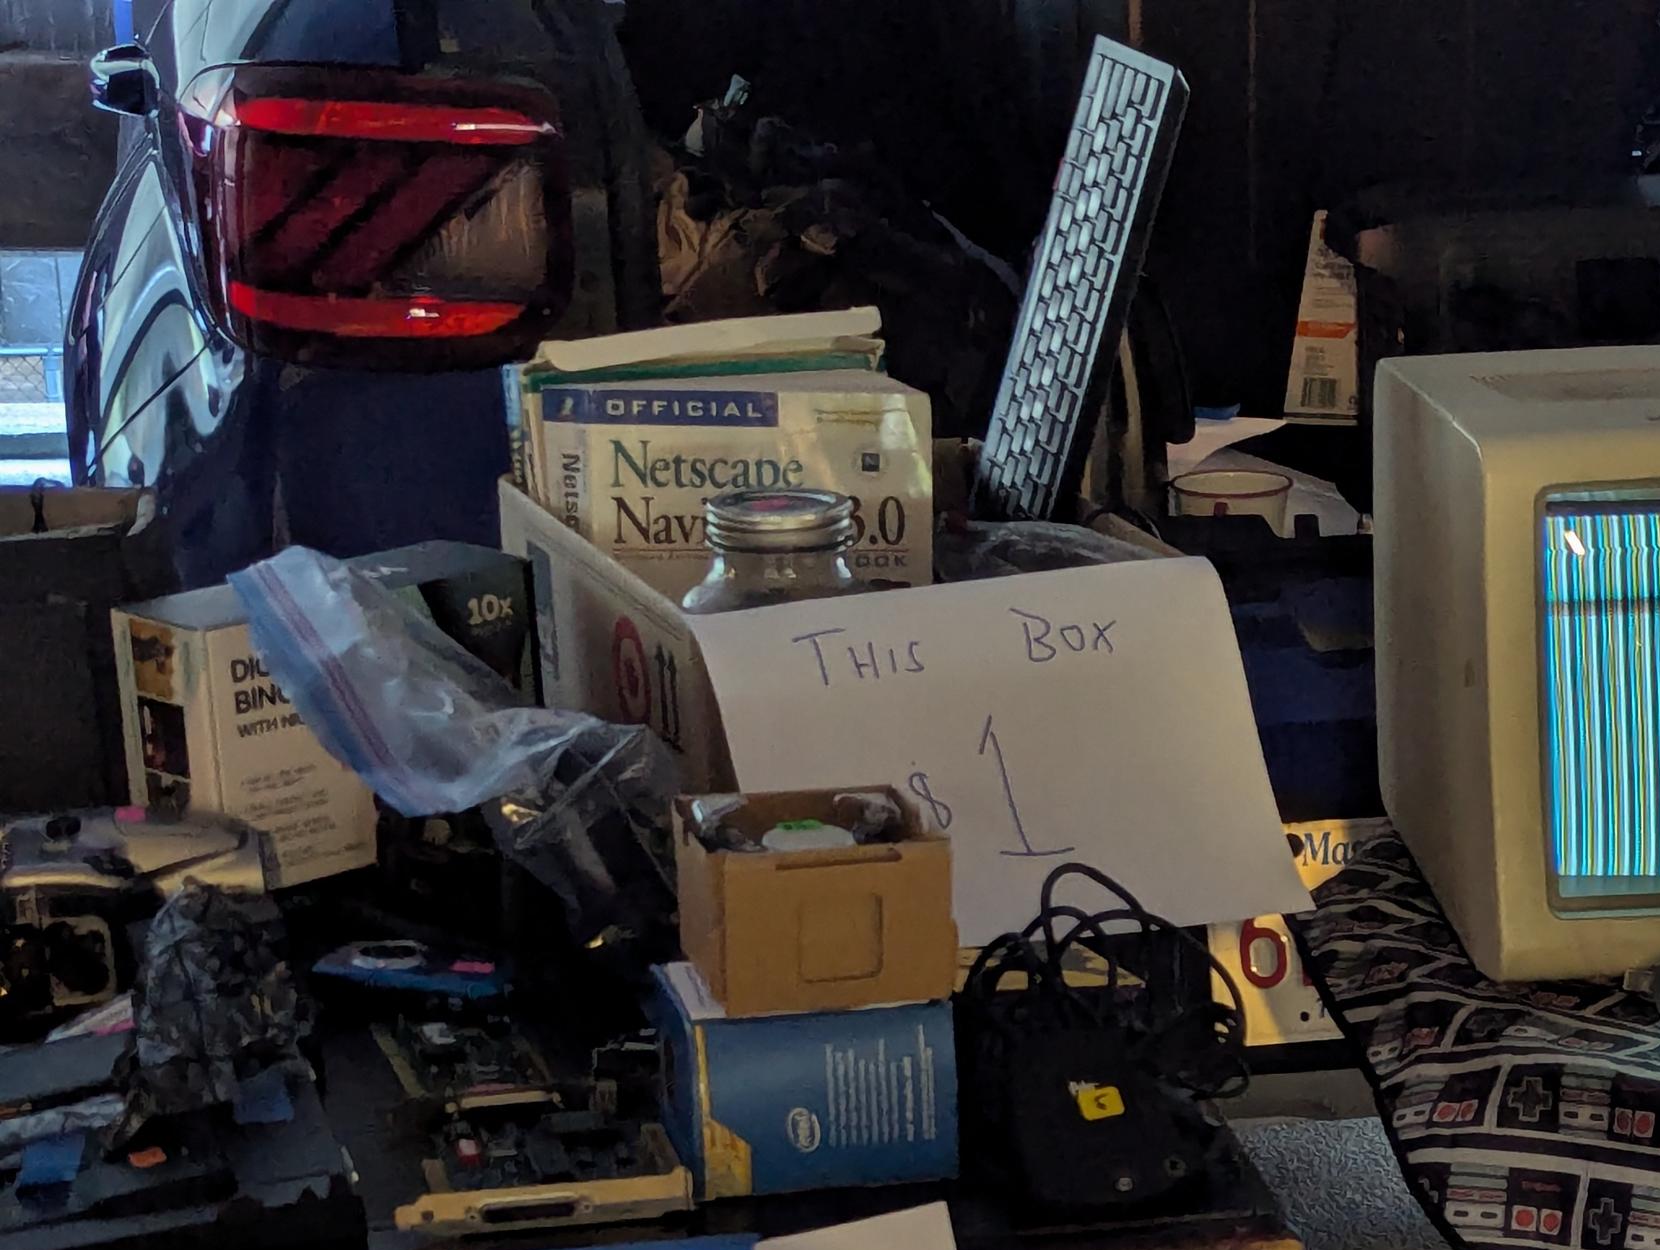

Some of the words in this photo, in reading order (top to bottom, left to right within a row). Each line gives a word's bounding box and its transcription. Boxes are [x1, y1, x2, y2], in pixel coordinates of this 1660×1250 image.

[604, 398, 764, 418] OFFICIAL
[608, 439, 803, 489] Netscape
[856, 554, 907, 568] OOK
[467, 594, 514, 625] 10x
[792, 628, 925, 687] THIS
[1009, 607, 1118, 664] BOX
